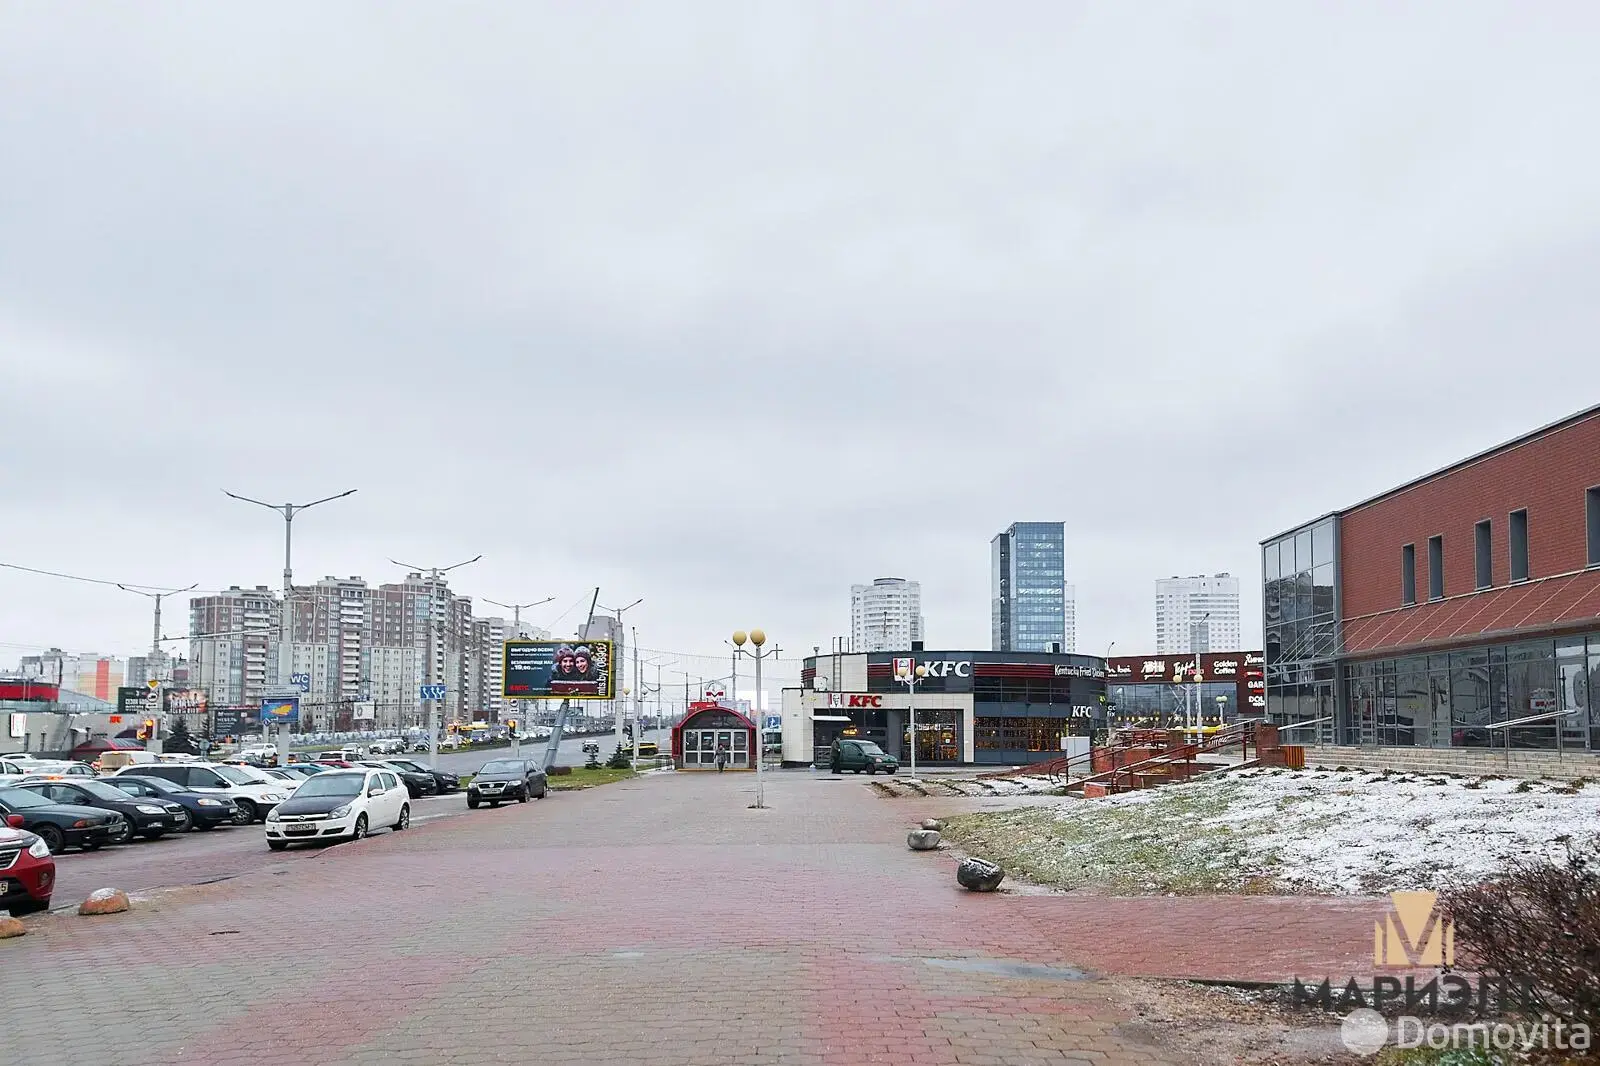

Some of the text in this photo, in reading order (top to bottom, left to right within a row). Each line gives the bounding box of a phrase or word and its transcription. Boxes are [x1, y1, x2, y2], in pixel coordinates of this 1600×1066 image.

[922, 661, 971, 677] KFC
[1213, 660, 1238, 668] Golden
[1054, 664, 1079, 678] Kentucky
[1079, 666, 1091, 677] Fried
[1214, 667, 1236, 675] Coffee
[291, 674, 309, 683] WC
[848, 695, 882, 707] KFC
[1072, 705, 1093, 718] KFC
